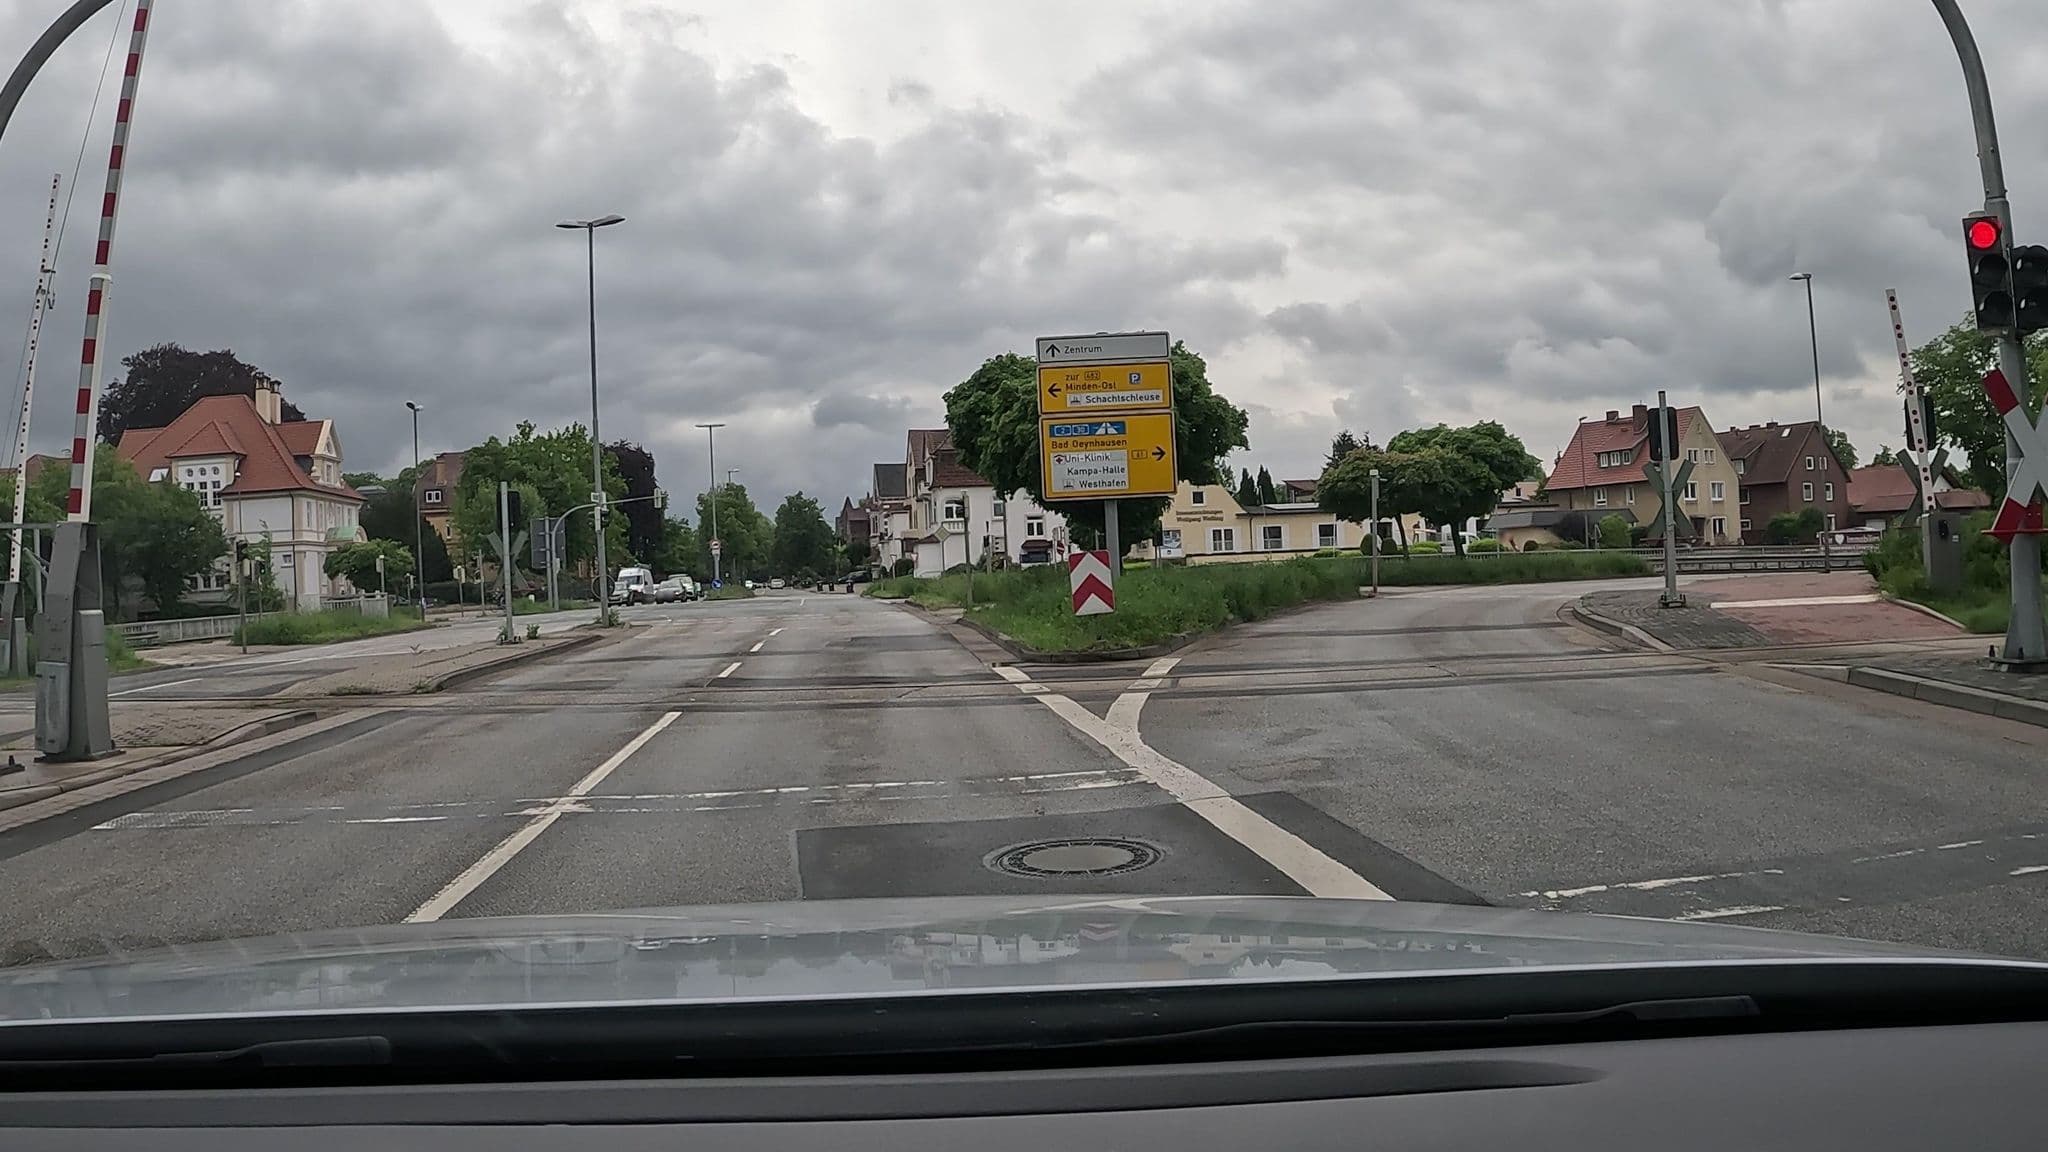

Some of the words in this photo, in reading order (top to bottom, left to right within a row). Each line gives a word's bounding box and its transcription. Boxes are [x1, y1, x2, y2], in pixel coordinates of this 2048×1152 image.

[1064, 345, 1102, 354] Zentrum
[1065, 382, 1116, 391] Minden-Ost
[1085, 393, 1161, 404] Schachtschleuse
[1052, 441, 1069, 449] Bad
[1072, 439, 1127, 449] Oeynhausen
[1064, 454, 1110, 464] Uni-Klinik
[1067, 466, 1126, 477] Kampa-Halle
[1079, 479, 1127, 489] Westhafen
